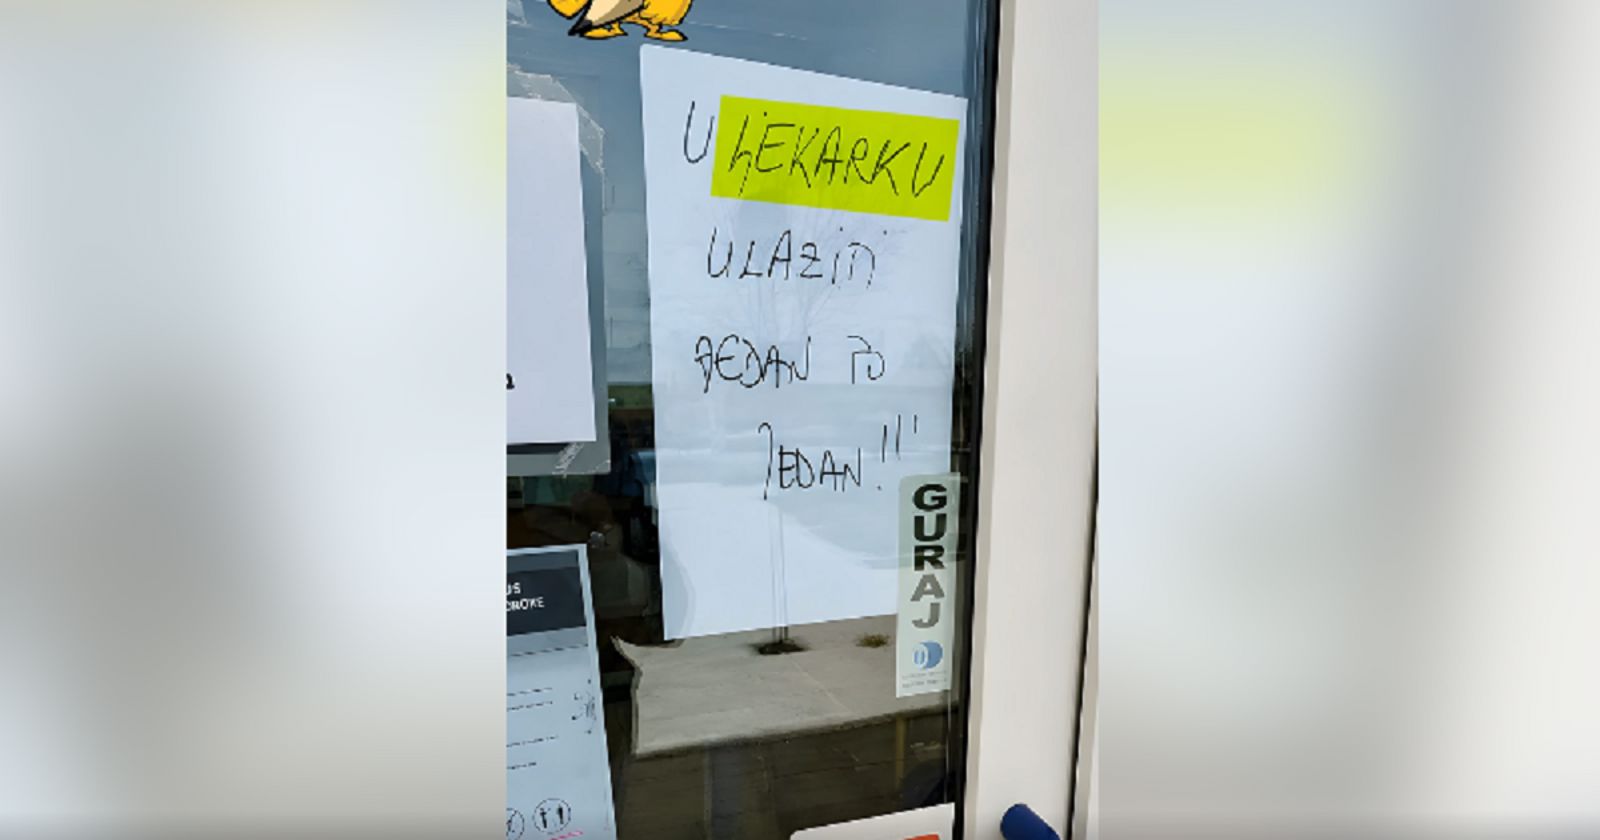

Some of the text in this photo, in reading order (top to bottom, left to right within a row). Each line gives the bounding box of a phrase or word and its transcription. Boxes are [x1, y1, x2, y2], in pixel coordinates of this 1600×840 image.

[683, 101, 715, 164] U
[694, 334, 812, 394] JEDAN
[910, 483, 948, 629] GURAJ
